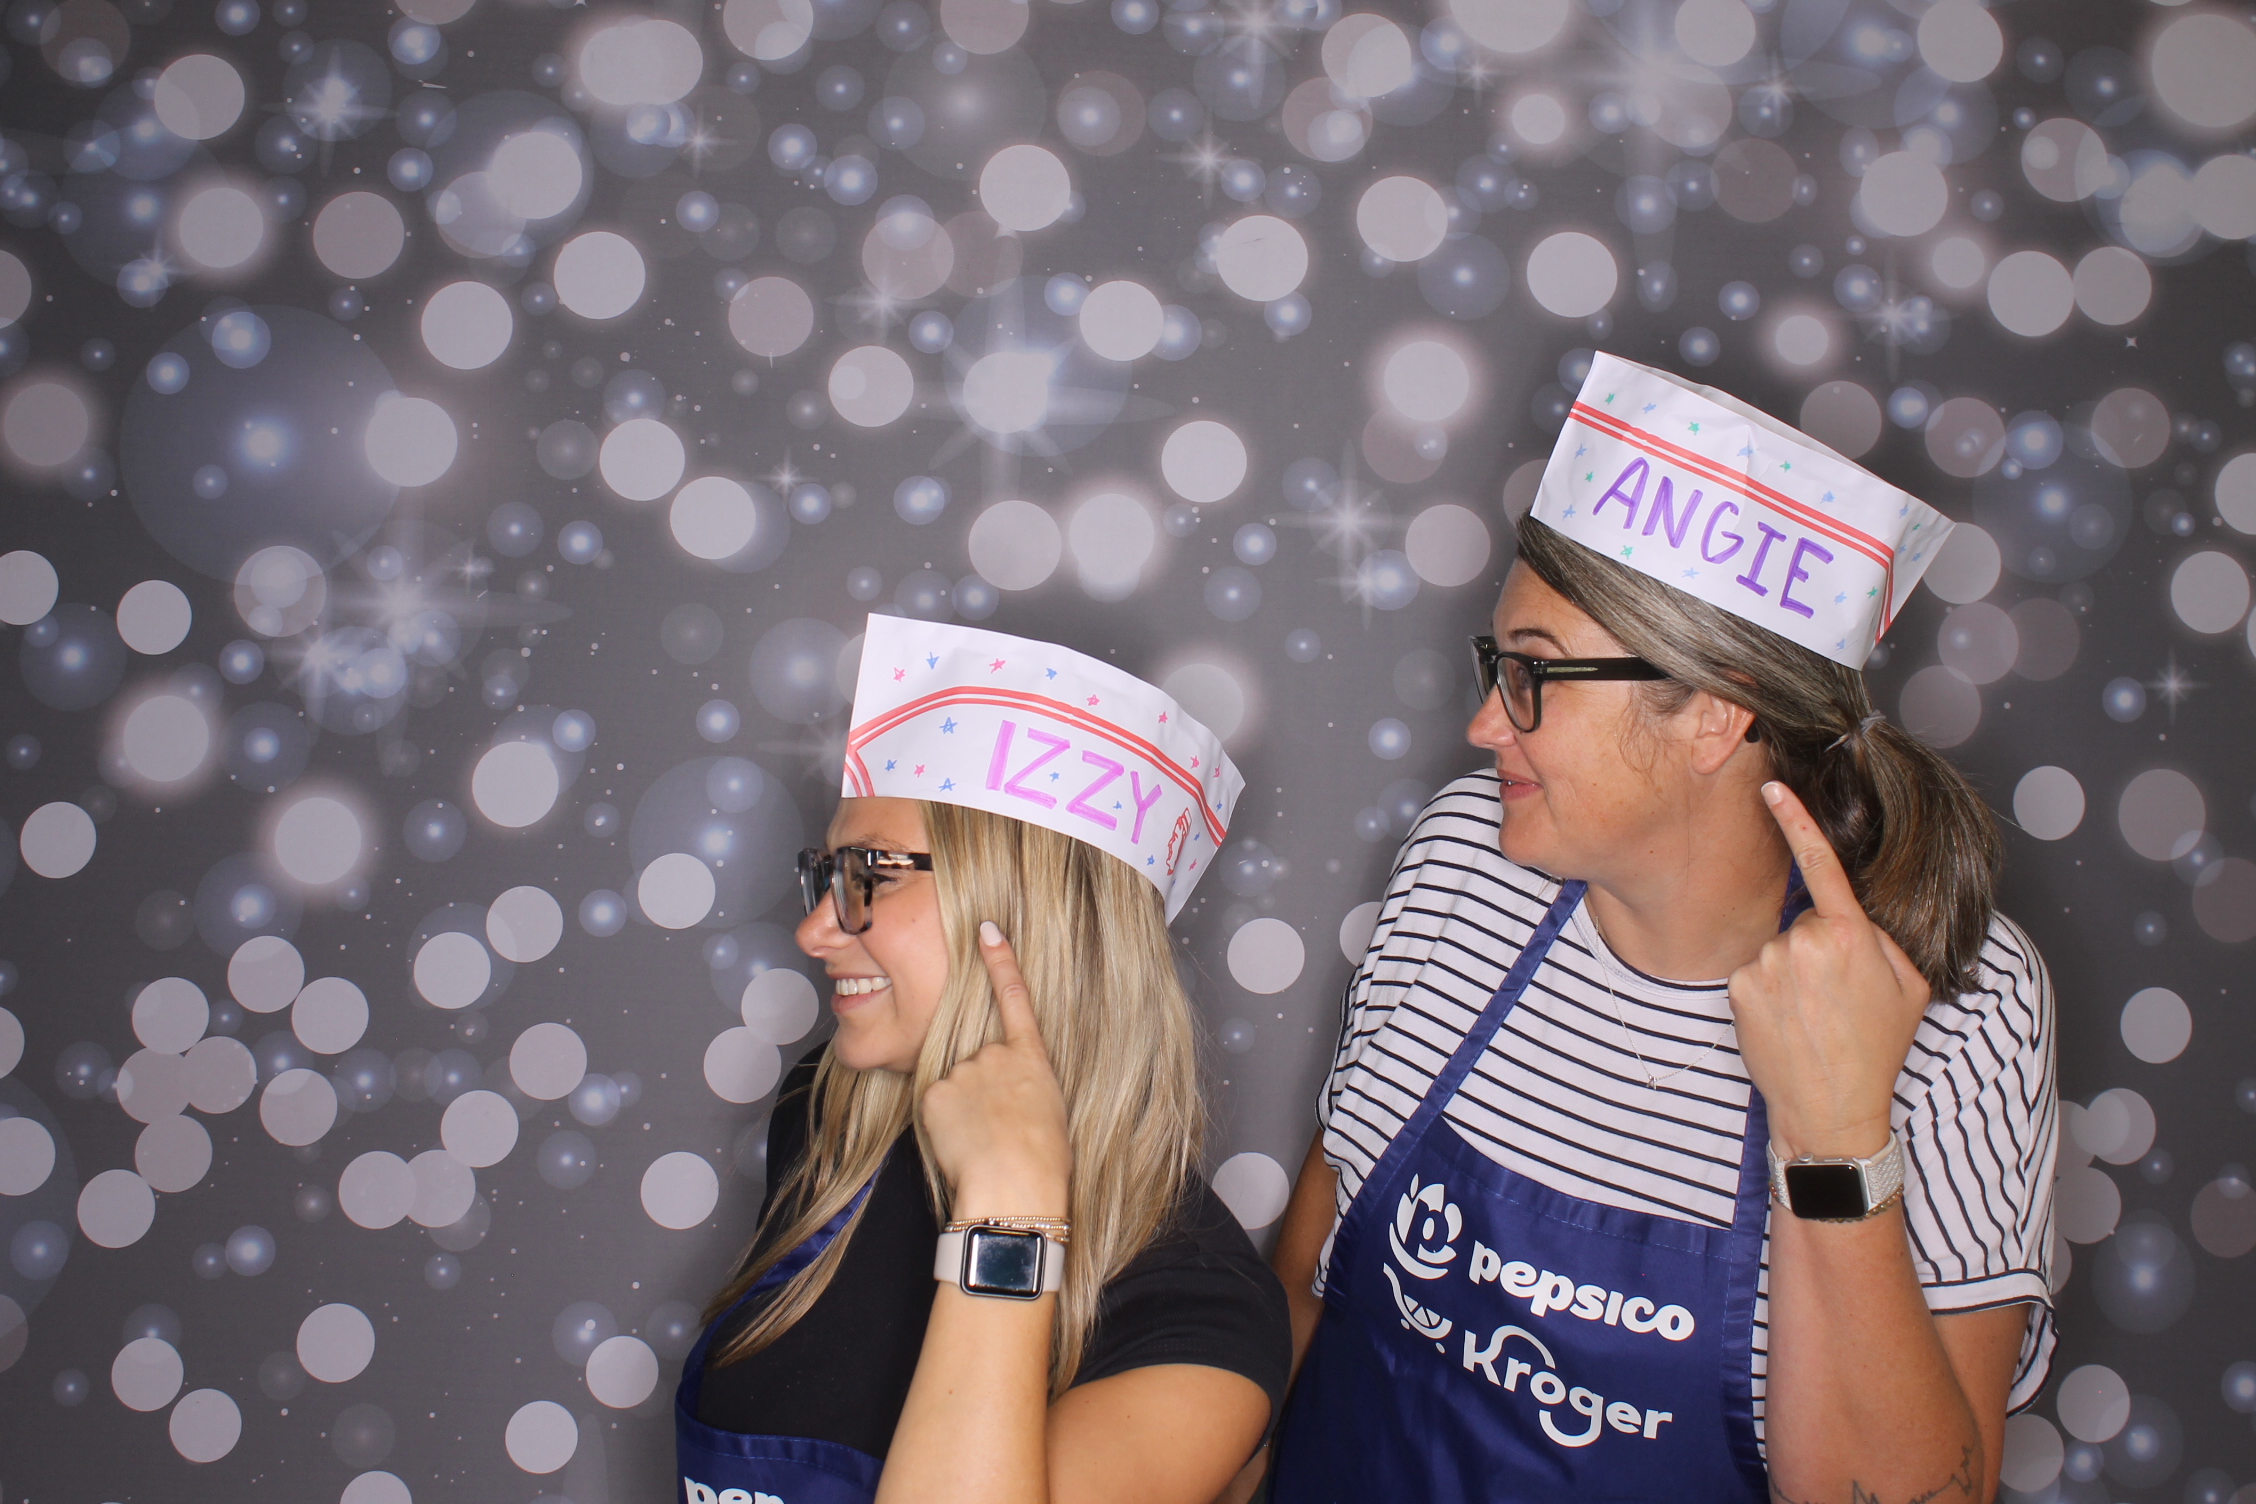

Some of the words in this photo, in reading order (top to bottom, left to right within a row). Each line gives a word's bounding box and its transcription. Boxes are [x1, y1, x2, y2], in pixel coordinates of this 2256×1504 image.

[1592, 456, 1834, 619] ANGIE
[985, 719, 1163, 845] IZZY
[1469, 1240, 1695, 1341] pepsico
[1463, 1324, 1673, 1447] Kroger
